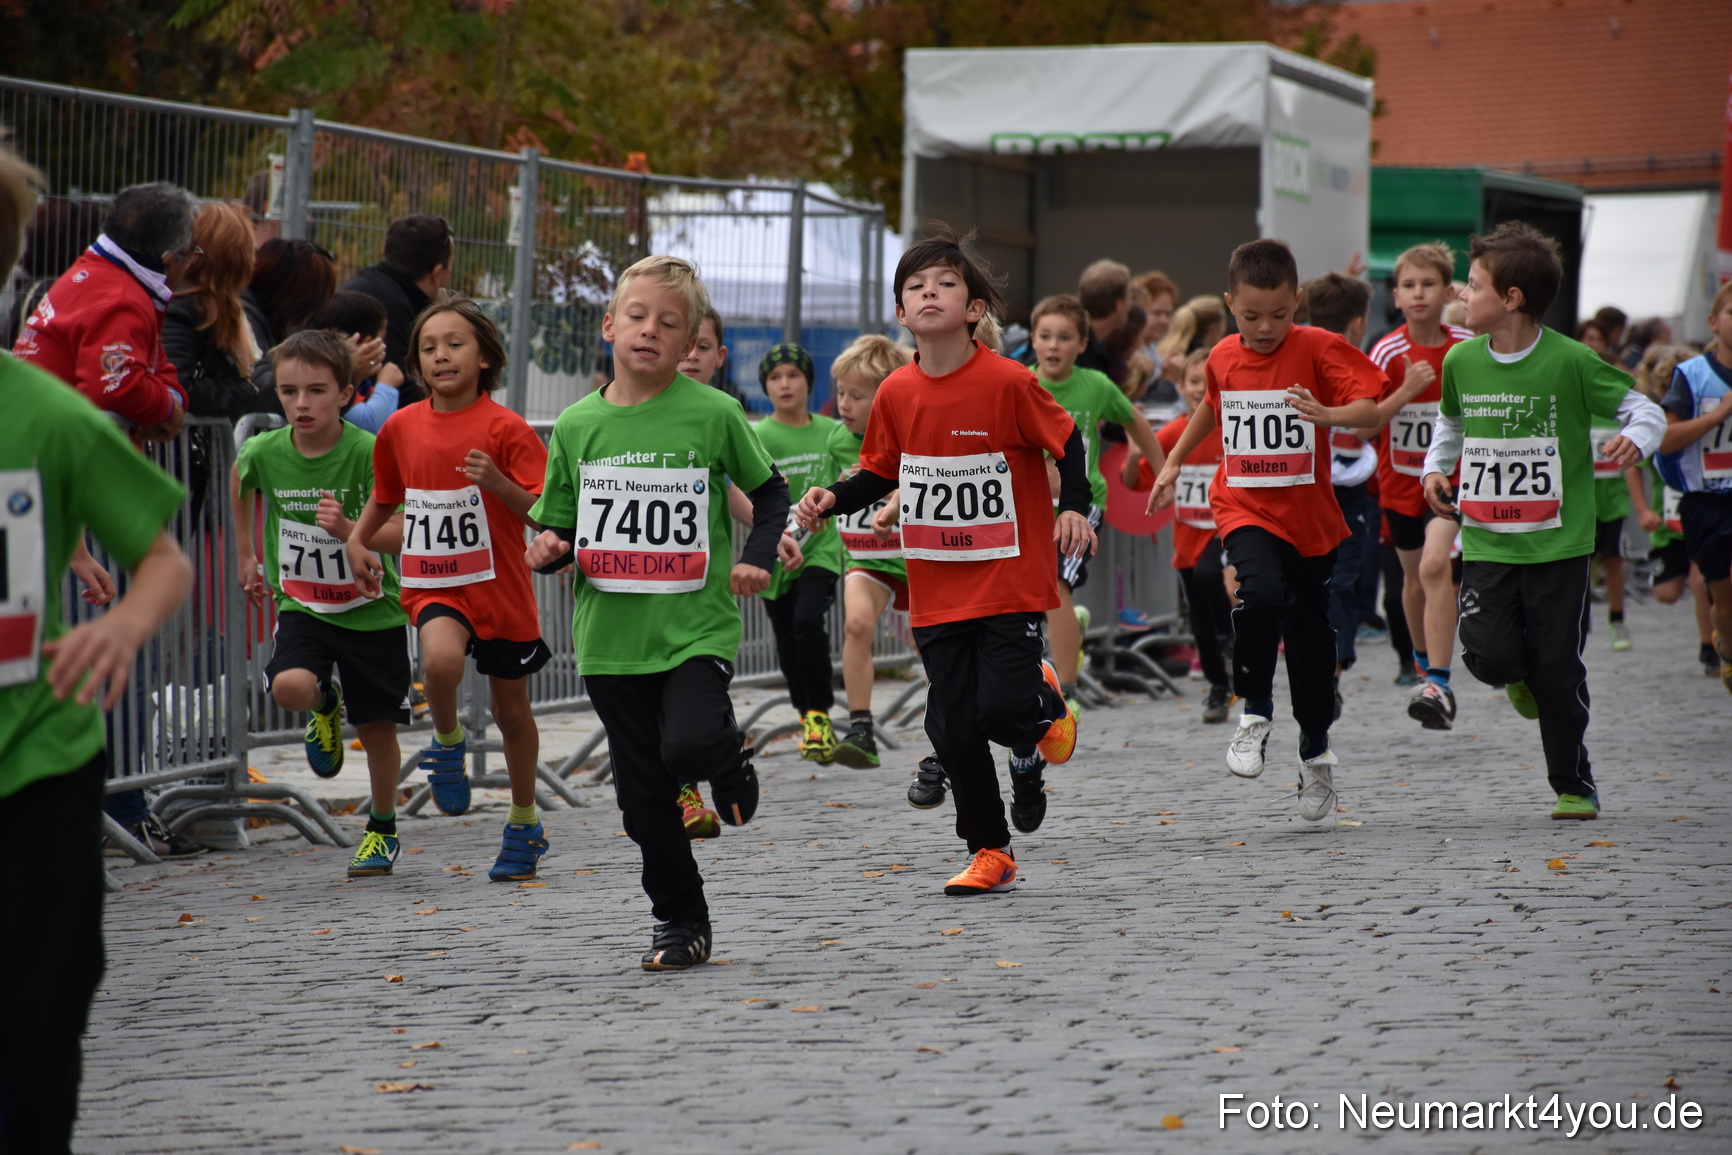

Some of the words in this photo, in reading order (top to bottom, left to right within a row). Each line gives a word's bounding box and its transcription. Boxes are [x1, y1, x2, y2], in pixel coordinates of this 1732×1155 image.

[1223, 401, 1245, 410] PARTL
[1247, 401, 1294, 410] Neumark
[1462, 393, 1526, 404] Neumarkter
[1463, 406, 1512, 419] Stadtlauf
[1228, 414, 1305, 450] 7105
[1398, 421, 1432, 448] 70
[1464, 448, 1491, 457] PARTL
[1493, 448, 1541, 458] Neumarkt
[902, 464, 934, 477] PARTL
[936, 464, 992, 477] Neumarkt
[1241, 460, 1288, 473] Skelzen
[1470, 461, 1551, 496] 7125
[583, 479, 622, 491] PARTL
[626, 481, 688, 493] Neumarkt
[1182, 481, 1206, 504] 71
[422, 500, 467, 510] Neumarkt
[909, 479, 1004, 521] 7208
[1493, 506, 1522, 520] Luis
[591, 498, 698, 546] 7403
[282, 528, 310, 543] PARTL
[311, 536, 347, 545] Neuma
[405, 512, 479, 550] 7146
[881, 537, 901, 549] Jos
[941, 532, 973, 546] Luis
[289, 544, 346, 580] 711
[420, 560, 458, 574] David
[590, 553, 692, 575] BENEDIKT
[313, 586, 351, 600] Lukas
